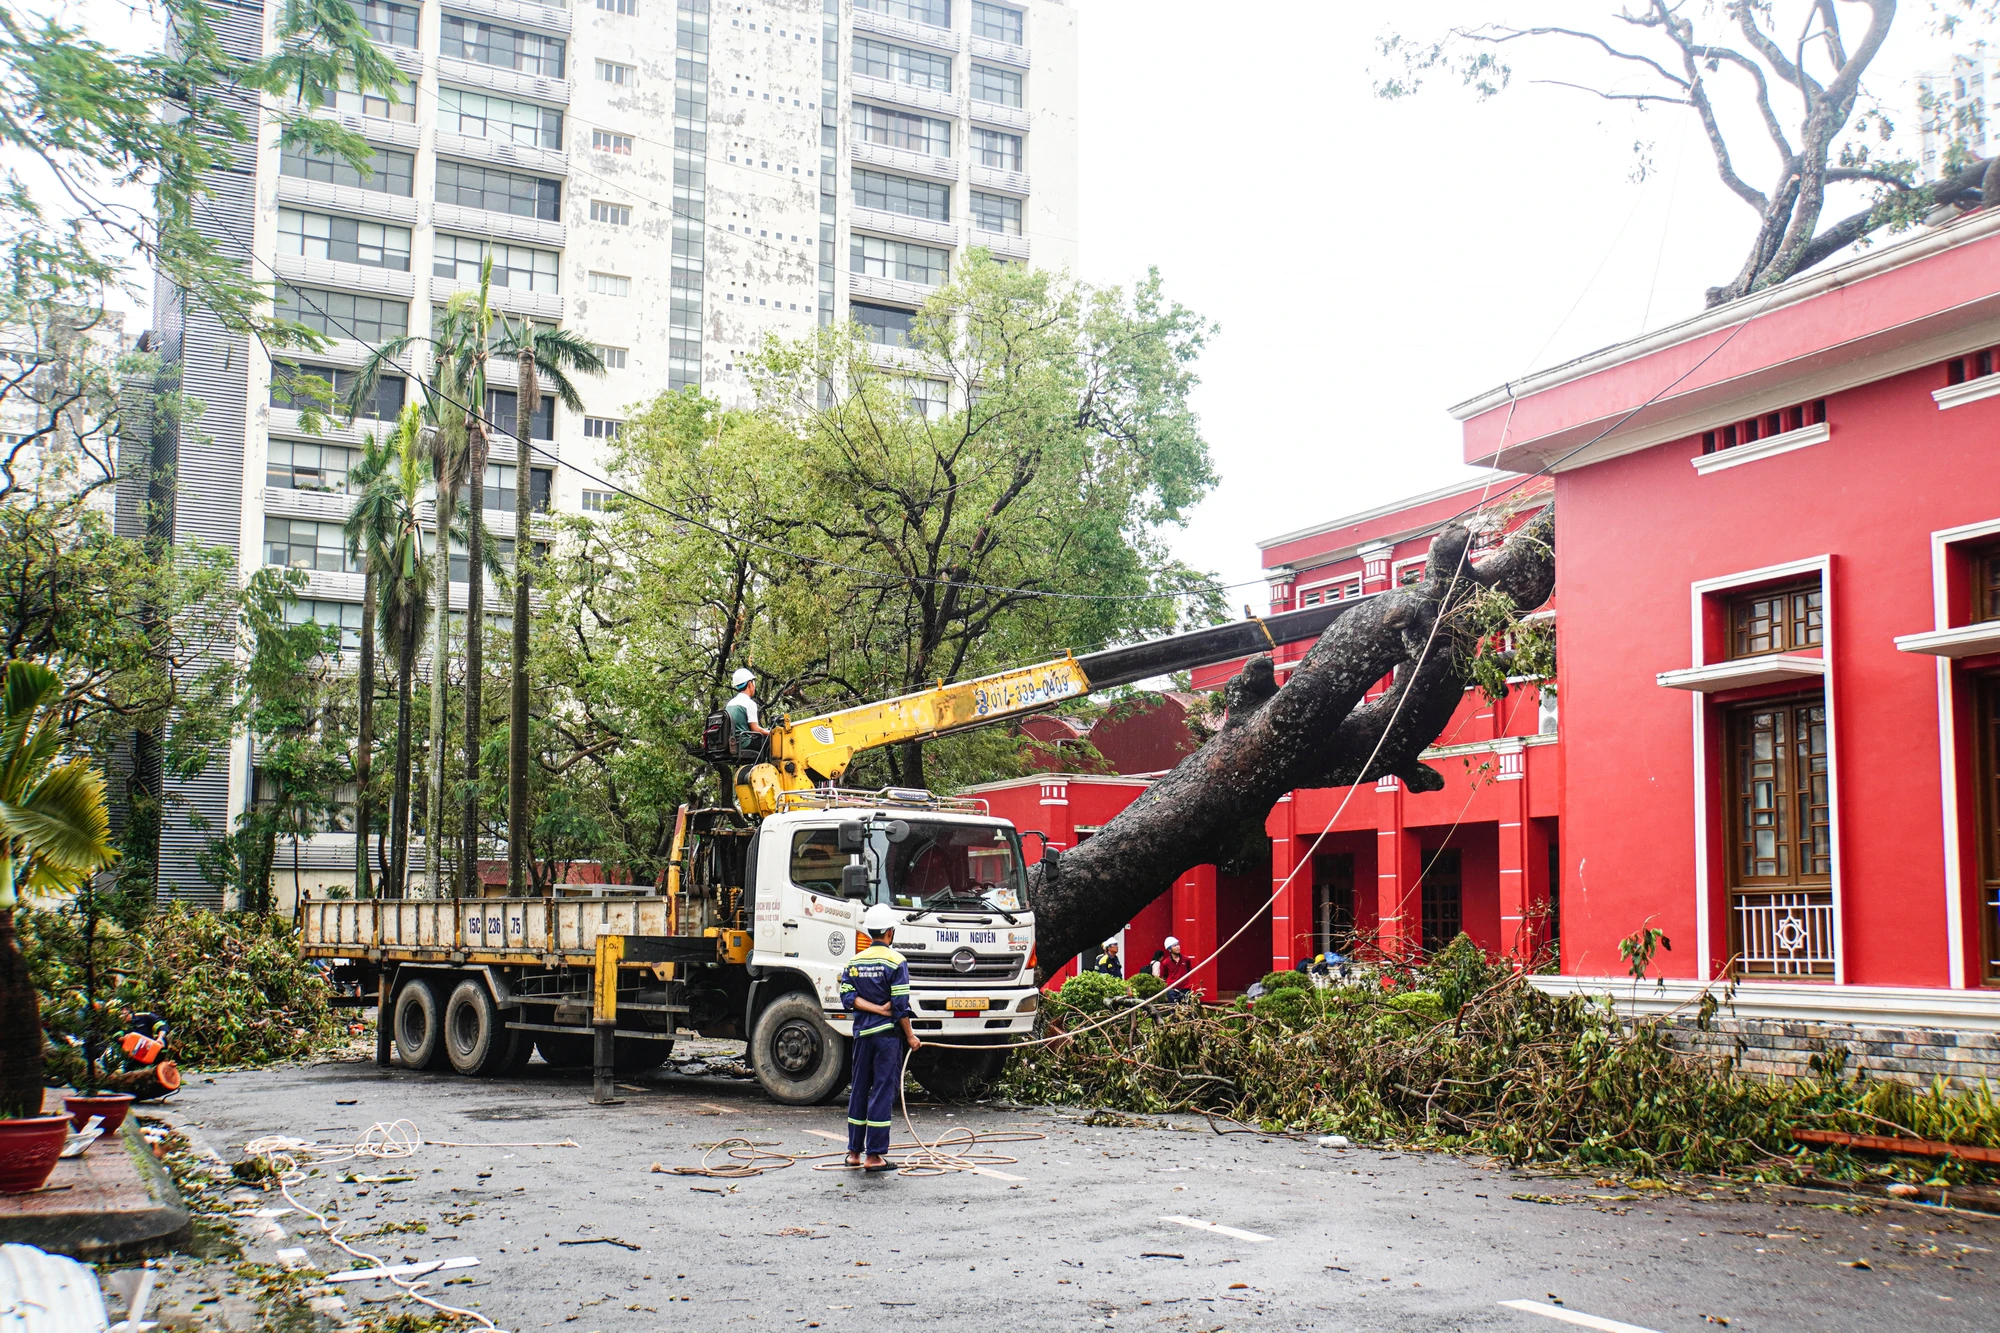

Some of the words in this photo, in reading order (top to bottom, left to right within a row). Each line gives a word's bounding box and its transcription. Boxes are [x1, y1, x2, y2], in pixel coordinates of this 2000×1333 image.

[824, 906, 852, 919] HINO
[468, 917, 481, 934] 15C
[488, 917, 501, 934] 236
